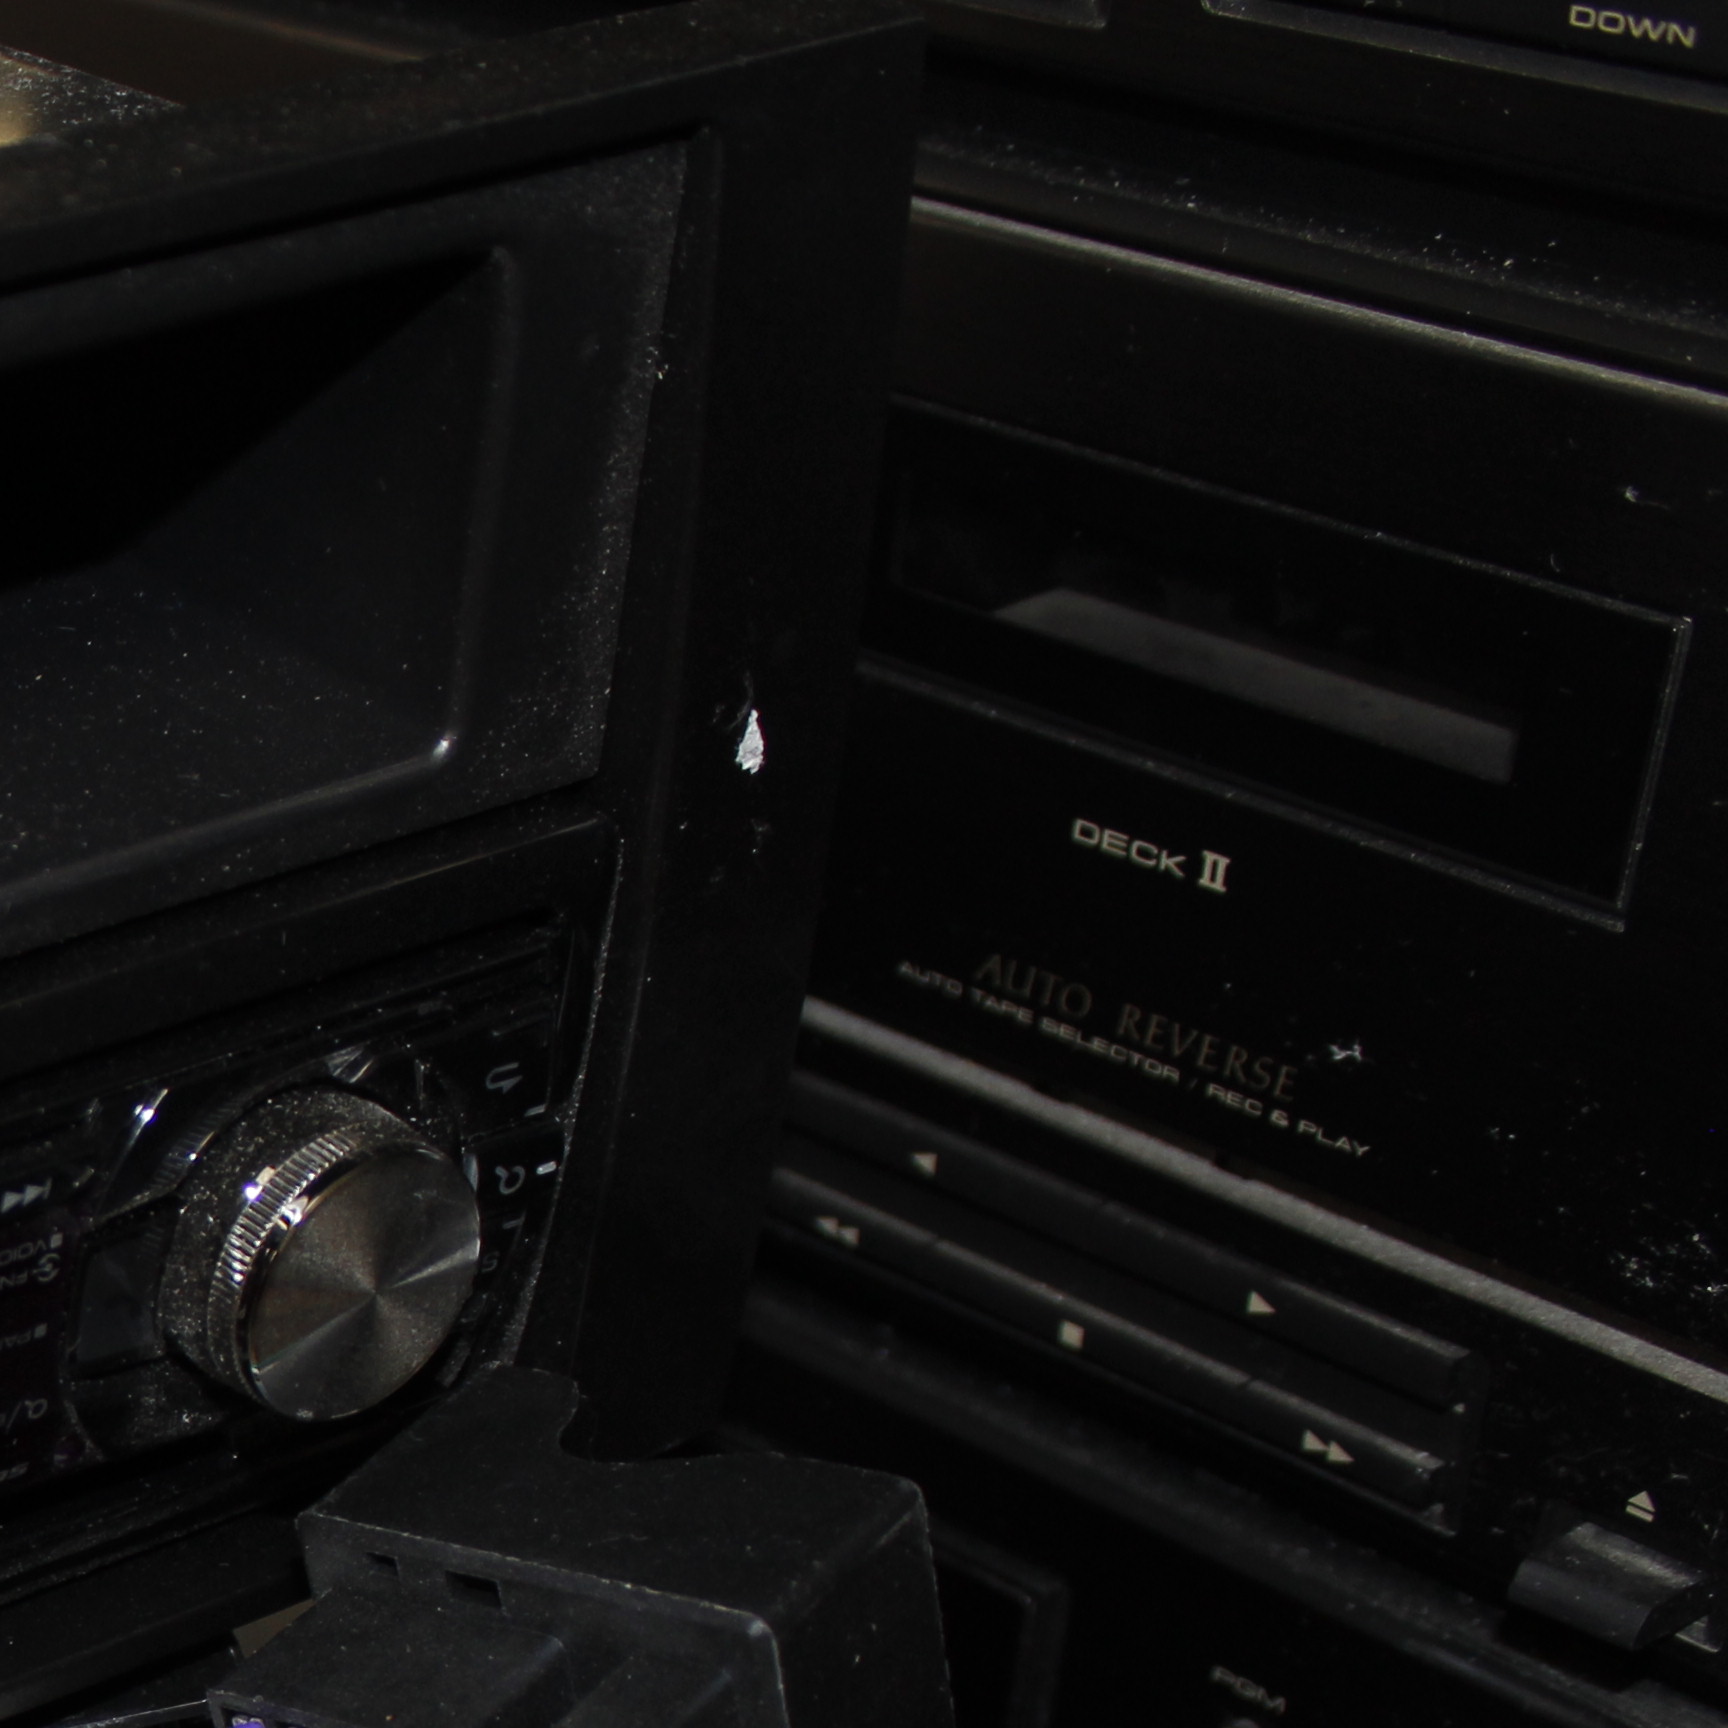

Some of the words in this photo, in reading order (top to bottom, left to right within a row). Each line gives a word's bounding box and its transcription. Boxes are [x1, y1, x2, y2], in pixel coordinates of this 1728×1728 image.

[1569, 4, 1696, 49] DOWN
[1072, 817, 1187, 881] DECK
[895, 960, 964, 998] AUTO
[972, 987, 1035, 1024] TAPE
[1039, 1016, 1181, 1085] SELECTOR
[1205, 1082, 1263, 1117] REC
[1269, 1109, 1289, 1128] &
[1297, 1119, 1371, 1157] PLAY
[974, 953, 1093, 1020] AUTO
[1115, 1002, 1298, 1101] REVERSE
[1210, 1664, 1287, 1716] PGM
